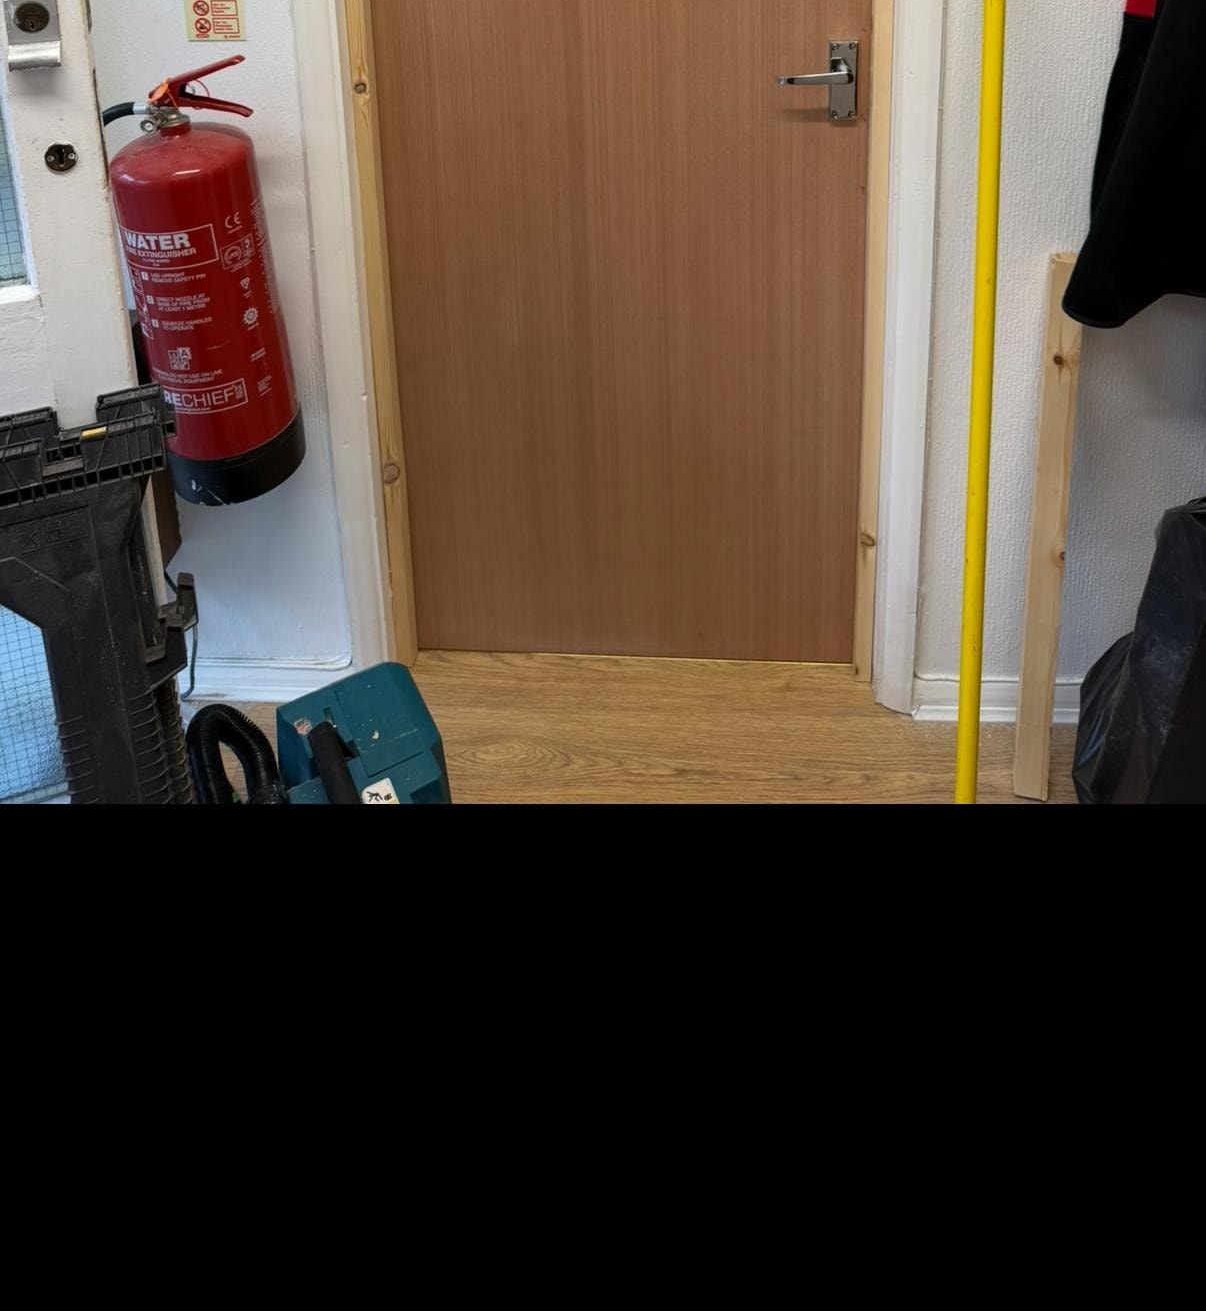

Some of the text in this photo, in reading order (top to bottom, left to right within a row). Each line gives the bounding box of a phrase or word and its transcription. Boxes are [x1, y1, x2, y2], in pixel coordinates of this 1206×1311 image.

[124, 230, 191, 251] WATER
[137, 247, 197, 259] EXTINGUISHER
[163, 387, 234, 408] RECHIEF
